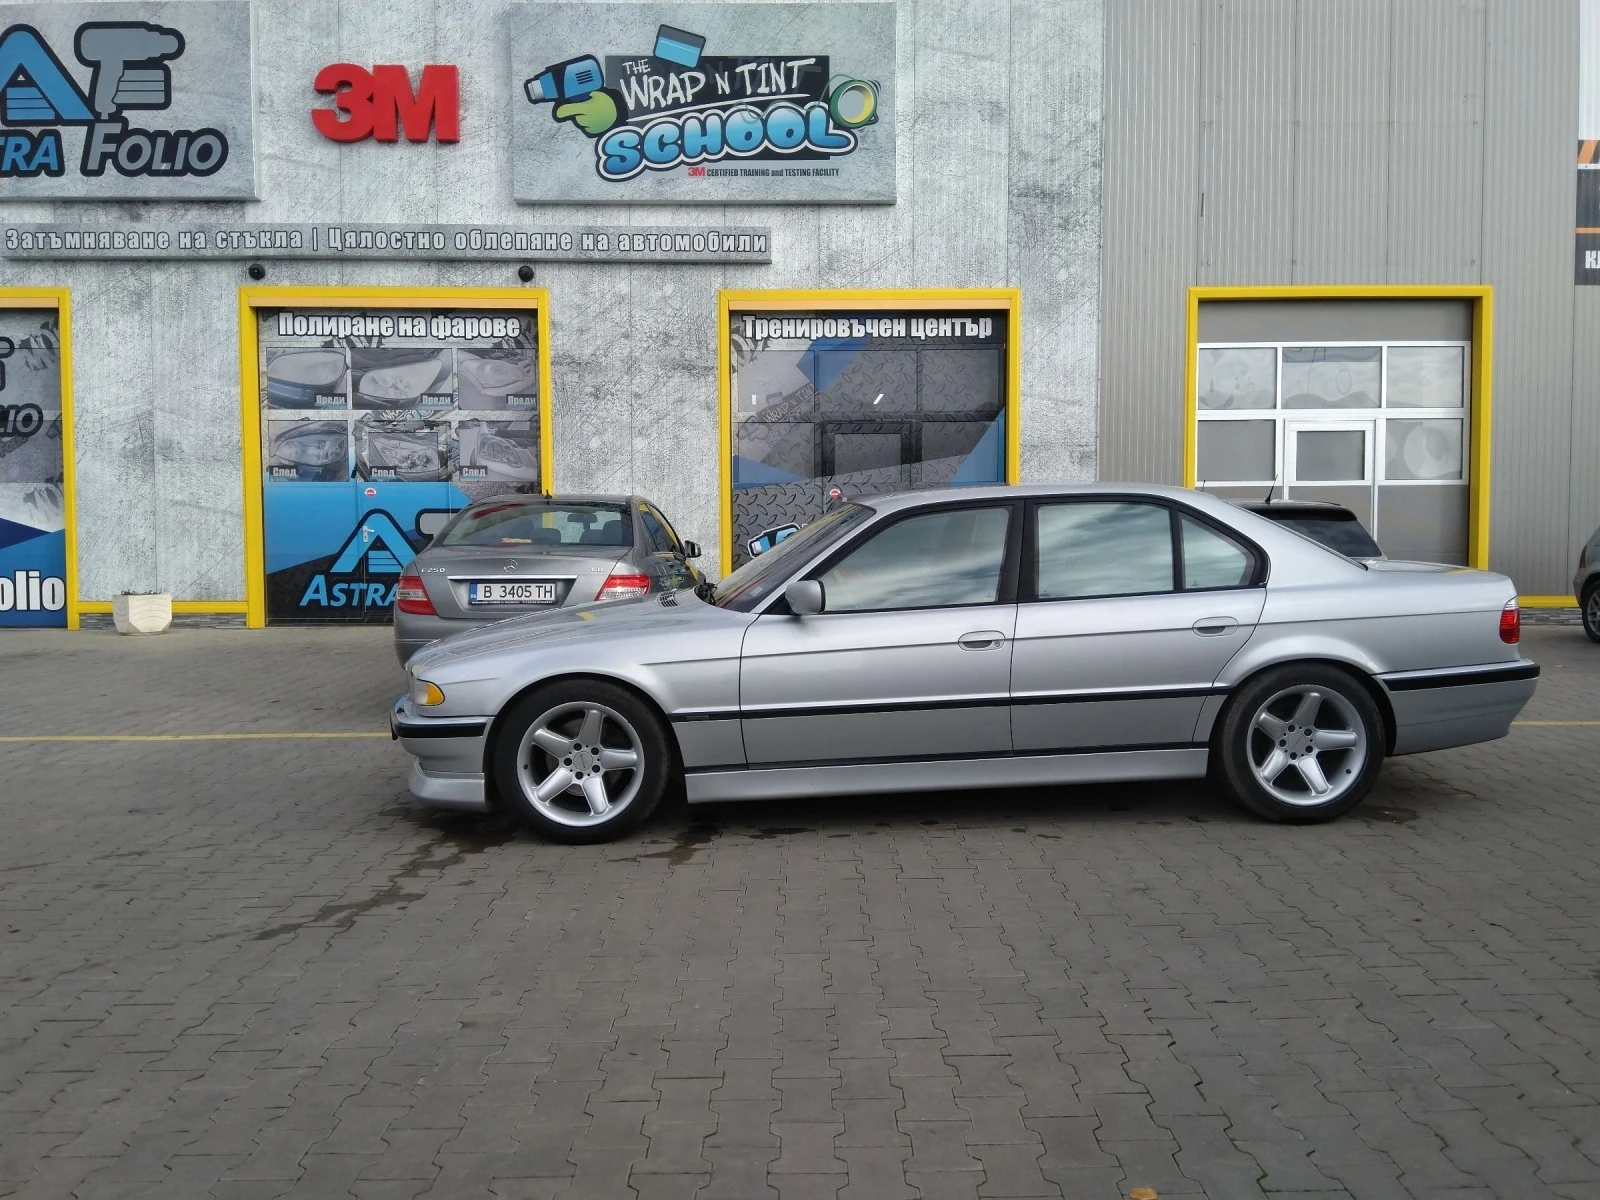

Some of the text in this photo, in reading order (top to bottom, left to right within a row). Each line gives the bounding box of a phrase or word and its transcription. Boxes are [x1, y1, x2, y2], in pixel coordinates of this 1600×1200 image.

[622, 59, 650, 75] THE
[620, 58, 816, 111] WRAP N TINT
[311, 63, 460, 143] 3M
[0, 122, 223, 171] RA FOLIO
[601, 104, 852, 177] SCHOOL
[687, 166, 840, 177] 3M CERTIFIED TRAINING and TESTING FACILITY
[5, 229, 171, 249] Затъмняване
[178, 231, 207, 249] на
[215, 231, 303, 249] стъкла
[328, 228, 446, 251] Цялостно
[454, 229, 573, 251] облепяне
[581, 233, 609, 251] на
[618, 231, 767, 252] автомобили
[278, 312, 520, 340] Полиране на фарове
[742, 315, 993, 340] Тренировъчен център
[316, 394, 345, 405] Преди
[422, 395, 451, 406] Преди
[507, 396, 536, 406] Преди
[0, 408, 39, 433] IO
[272, 466, 297, 478] След
[371, 468, 396, 478] След
[462, 466, 487, 478] След
[483, 585, 553, 599] B 3405 TH
